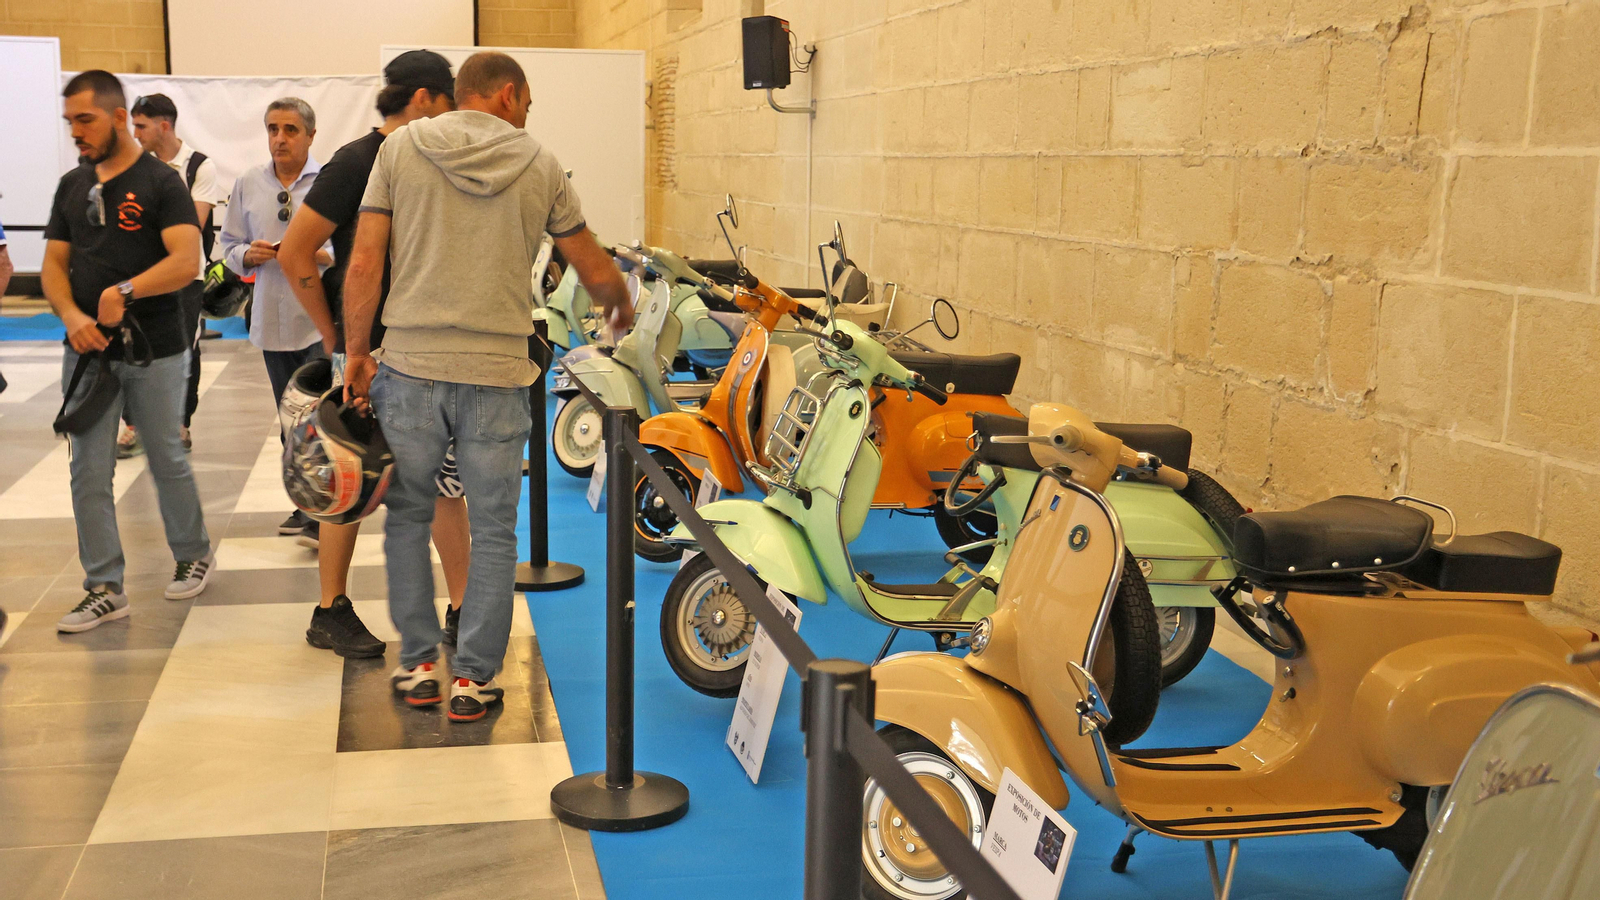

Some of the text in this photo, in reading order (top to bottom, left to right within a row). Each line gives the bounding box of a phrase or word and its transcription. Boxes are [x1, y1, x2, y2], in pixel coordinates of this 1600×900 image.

[1006, 783, 1042, 821] EXPOSICIÓN DE
[1012, 803, 1029, 823] MOTOS
[993, 831, 1008, 851] MARCA
